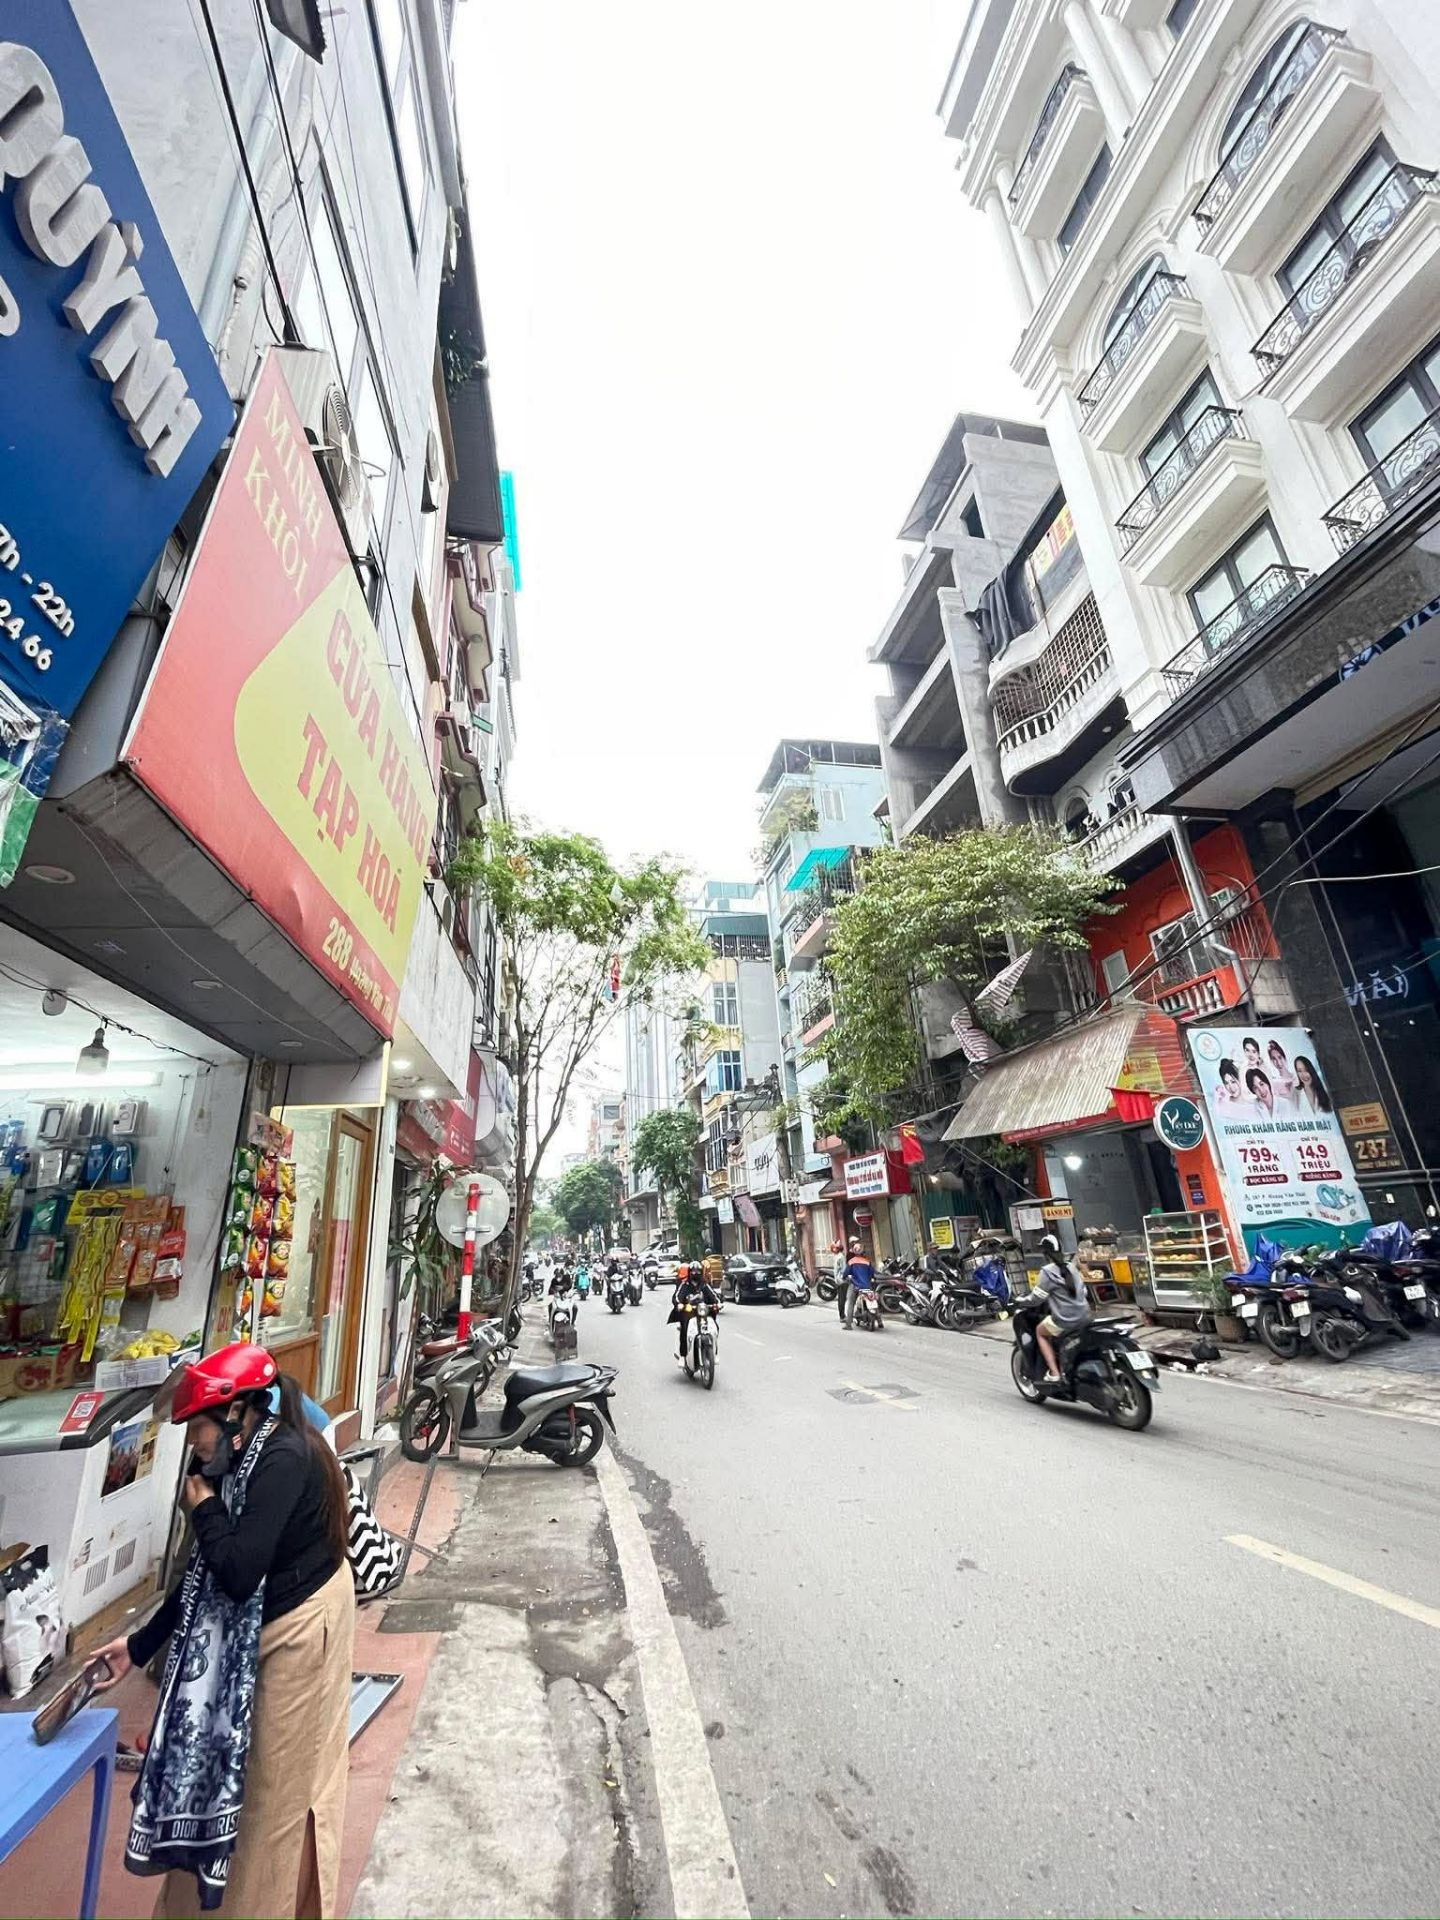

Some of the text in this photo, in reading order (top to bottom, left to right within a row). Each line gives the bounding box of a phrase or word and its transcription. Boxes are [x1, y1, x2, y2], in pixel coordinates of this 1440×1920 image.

[264, 386, 323, 547] MINH
[31, 582, 75, 638] 22h
[297, 712, 360, 854] TẠP
[322, 916, 354, 970] 288
[171, 1819, 199, 1839] DIOR
